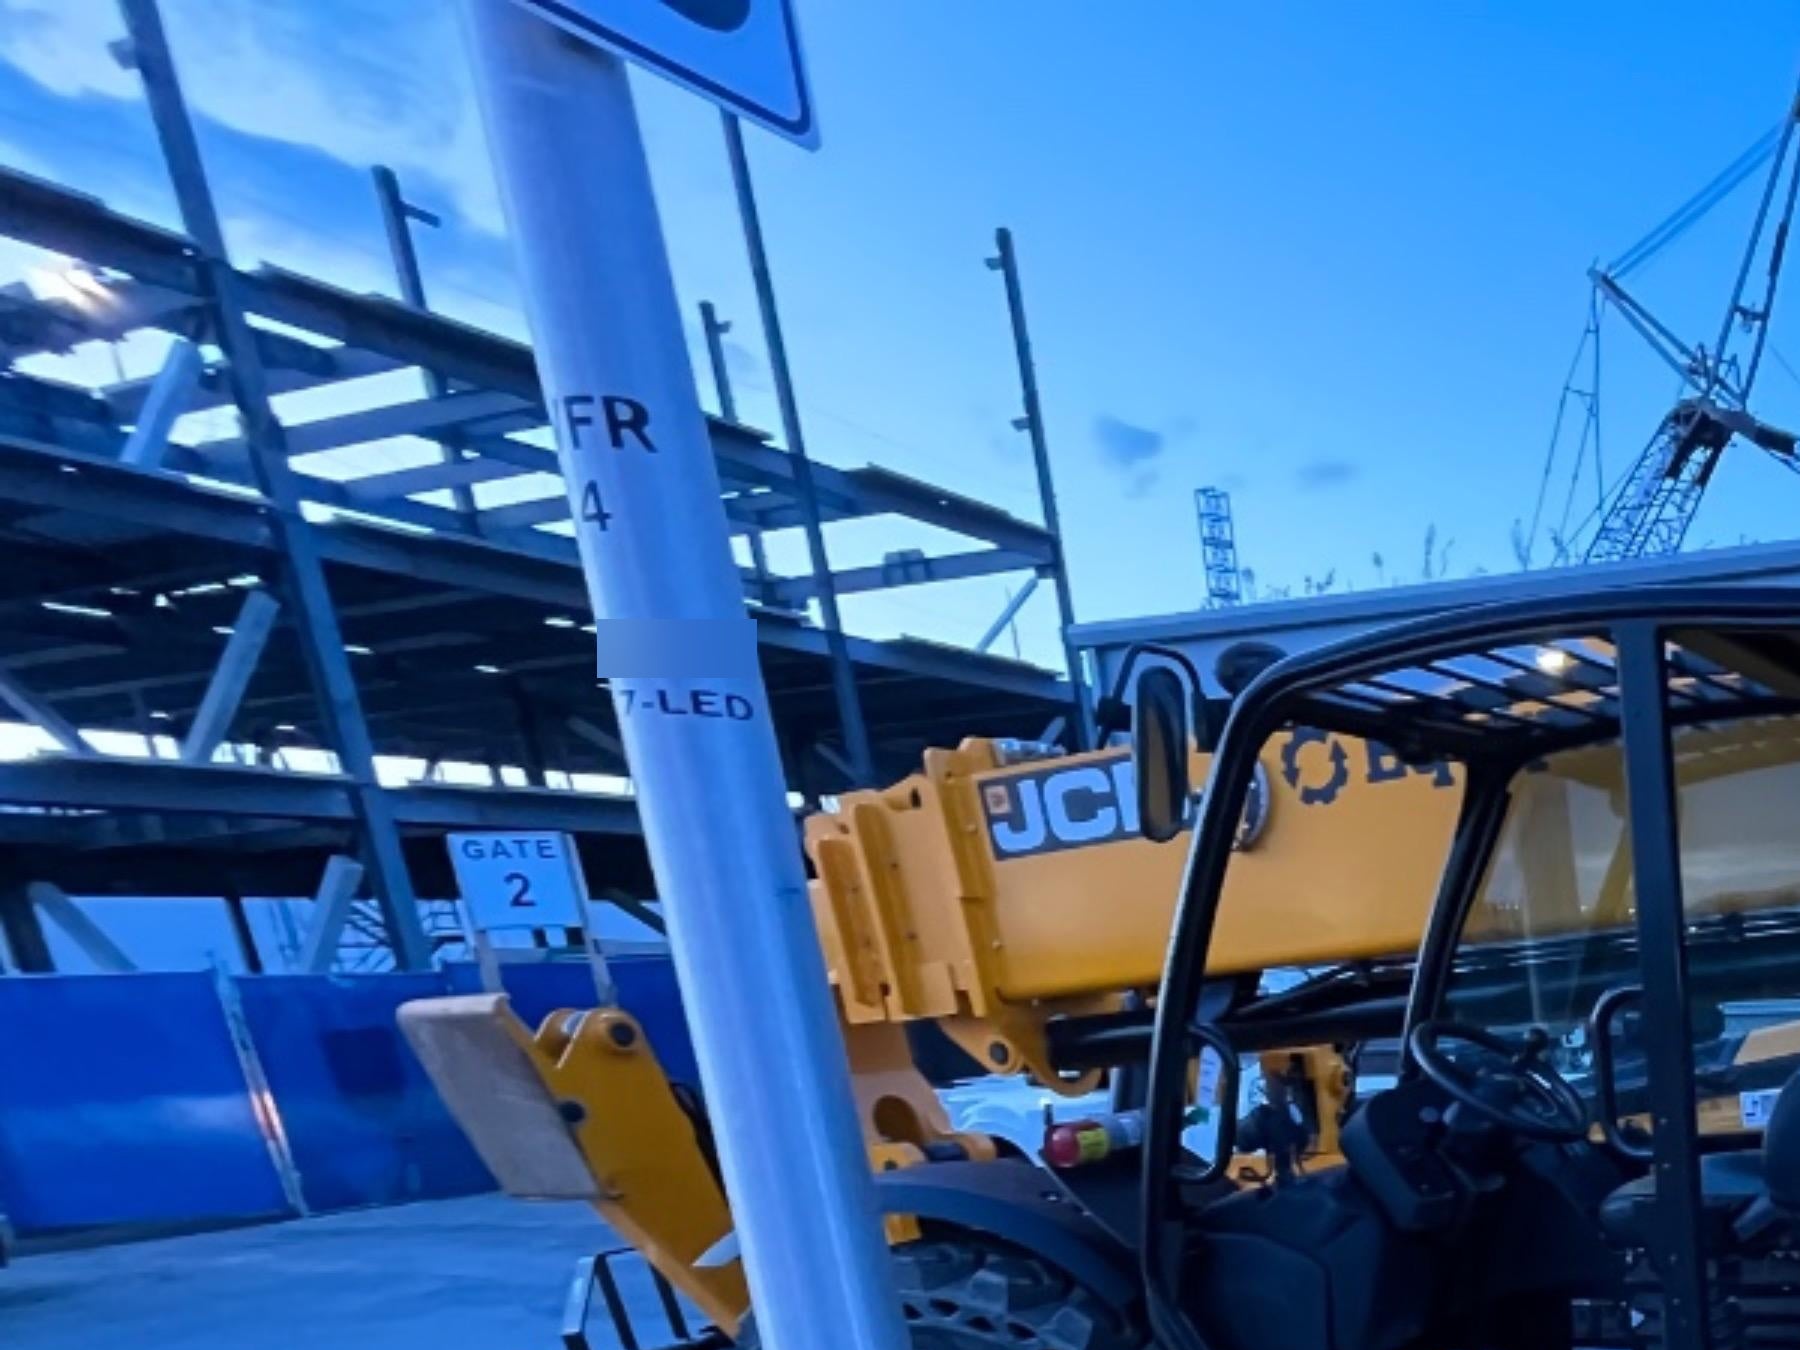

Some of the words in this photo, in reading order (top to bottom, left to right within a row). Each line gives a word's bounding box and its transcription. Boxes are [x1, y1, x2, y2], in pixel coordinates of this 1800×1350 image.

[554, 395, 659, 453] FR
[582, 479, 612, 531] 4
[461, 839, 557, 860] GATE
[503, 871, 538, 908] 2
